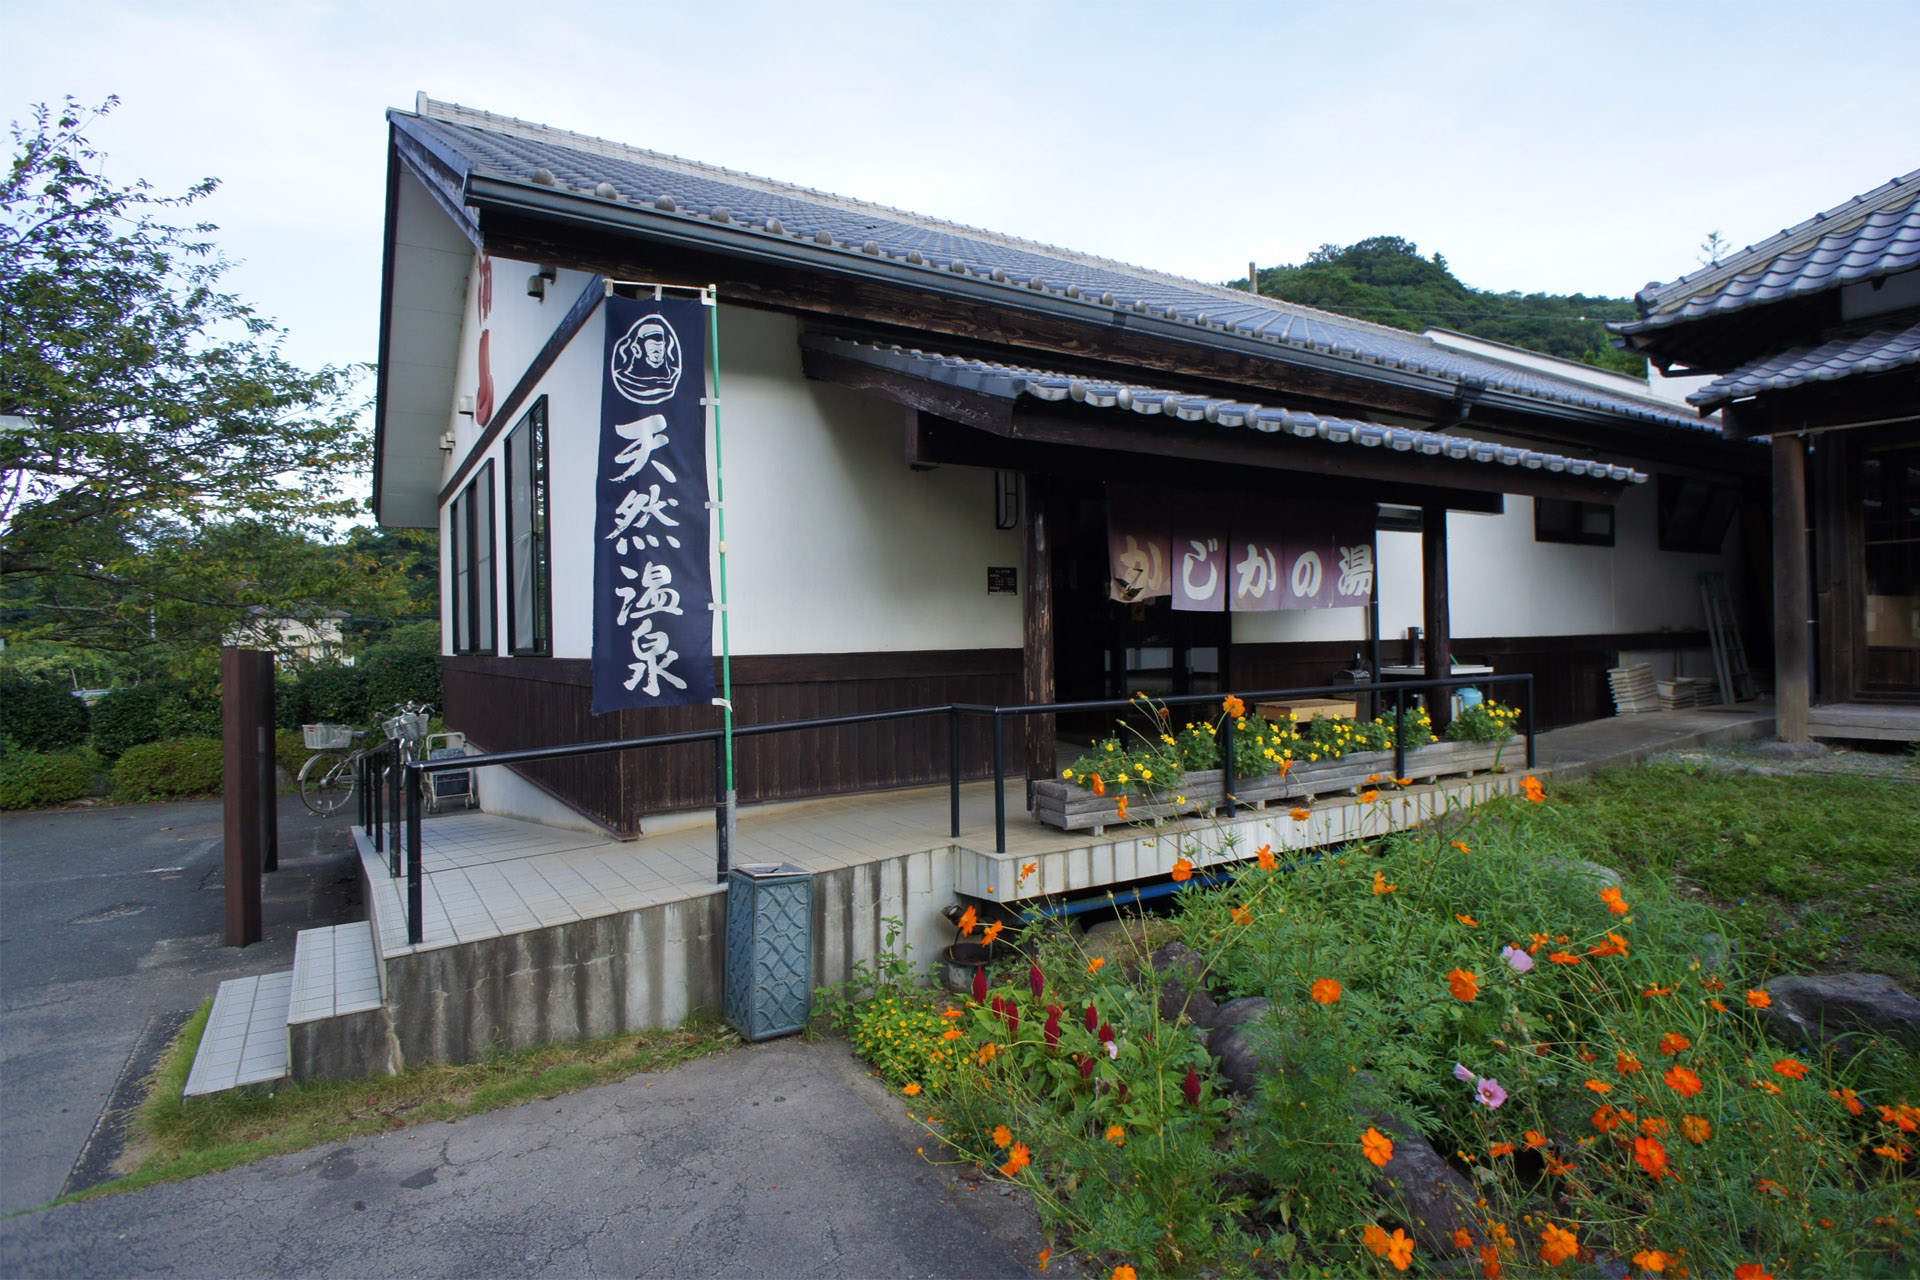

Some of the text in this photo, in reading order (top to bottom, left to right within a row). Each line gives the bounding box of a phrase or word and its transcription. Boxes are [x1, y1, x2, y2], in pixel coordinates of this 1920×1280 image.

[604, 414, 688, 696] 天然温泉
[1118, 535, 1374, 601] かじかの湯
